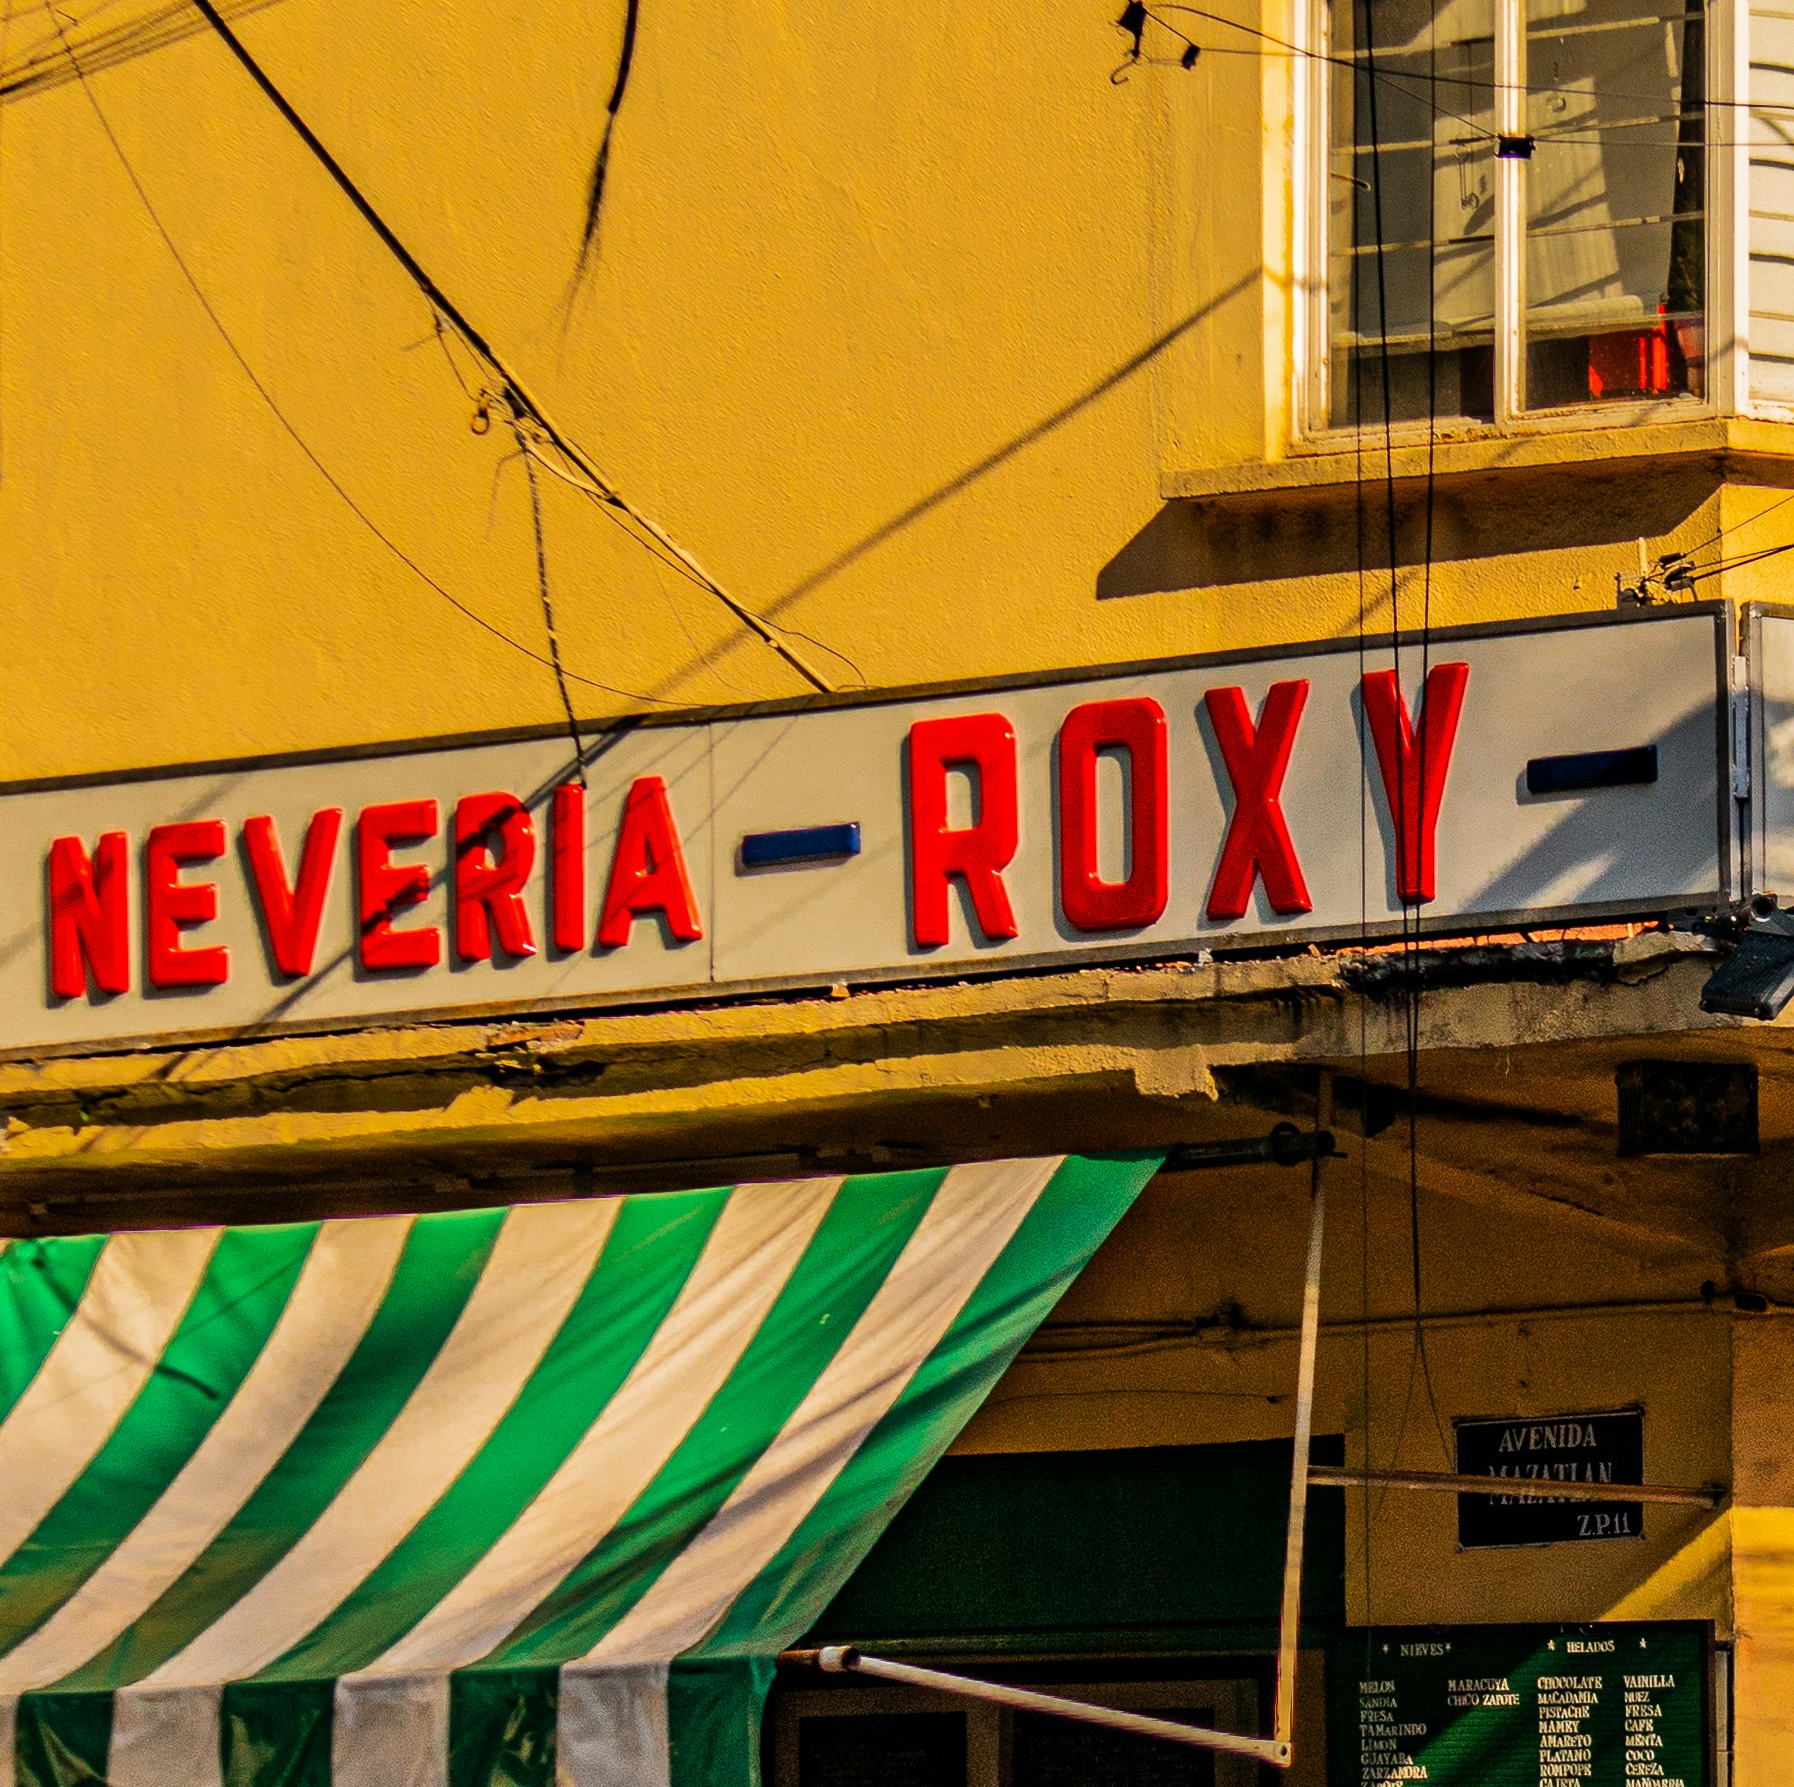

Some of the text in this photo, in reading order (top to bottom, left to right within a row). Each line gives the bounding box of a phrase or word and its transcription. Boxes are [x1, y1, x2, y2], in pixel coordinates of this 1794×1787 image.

[48, 662, 1471, 1001] NEVERIA ROXY
[1499, 1423, 1598, 1453] AVENIDA
[1399, 1643, 1444, 1657] NIEVES
[1566, 1639, 1616, 1653] HELADOS
[1359, 1679, 1396, 1694] MELON
[1447, 1677, 1510, 1693] MARACUYA
[1536, 1675, 1603, 1690] CHOCOLATE
[1622, 1674, 1676, 1689] VAINILLA
[1537, 1691, 1600, 1705] MACADAMIA
[1624, 1691, 1651, 1703] NUEZ
[1359, 1710, 1394, 1724] FRESA
[1539, 1705, 1591, 1720] PISTACHE
[1624, 1704, 1663, 1718] FRESA
[1539, 1720, 1581, 1734] MAMEY
[1540, 1734, 1592, 1748] AMARETO
[1625, 1734, 1664, 1748] MENTA
[1360, 1752, 1414, 1766] GUAYABA
[1539, 1748, 1592, 1763] PLATANO
[1625, 1749, 1656, 1762] COCO
[1539, 1763, 1592, 1777] ROMPOPE
[1625, 1763, 1665, 1776] CEREZA
